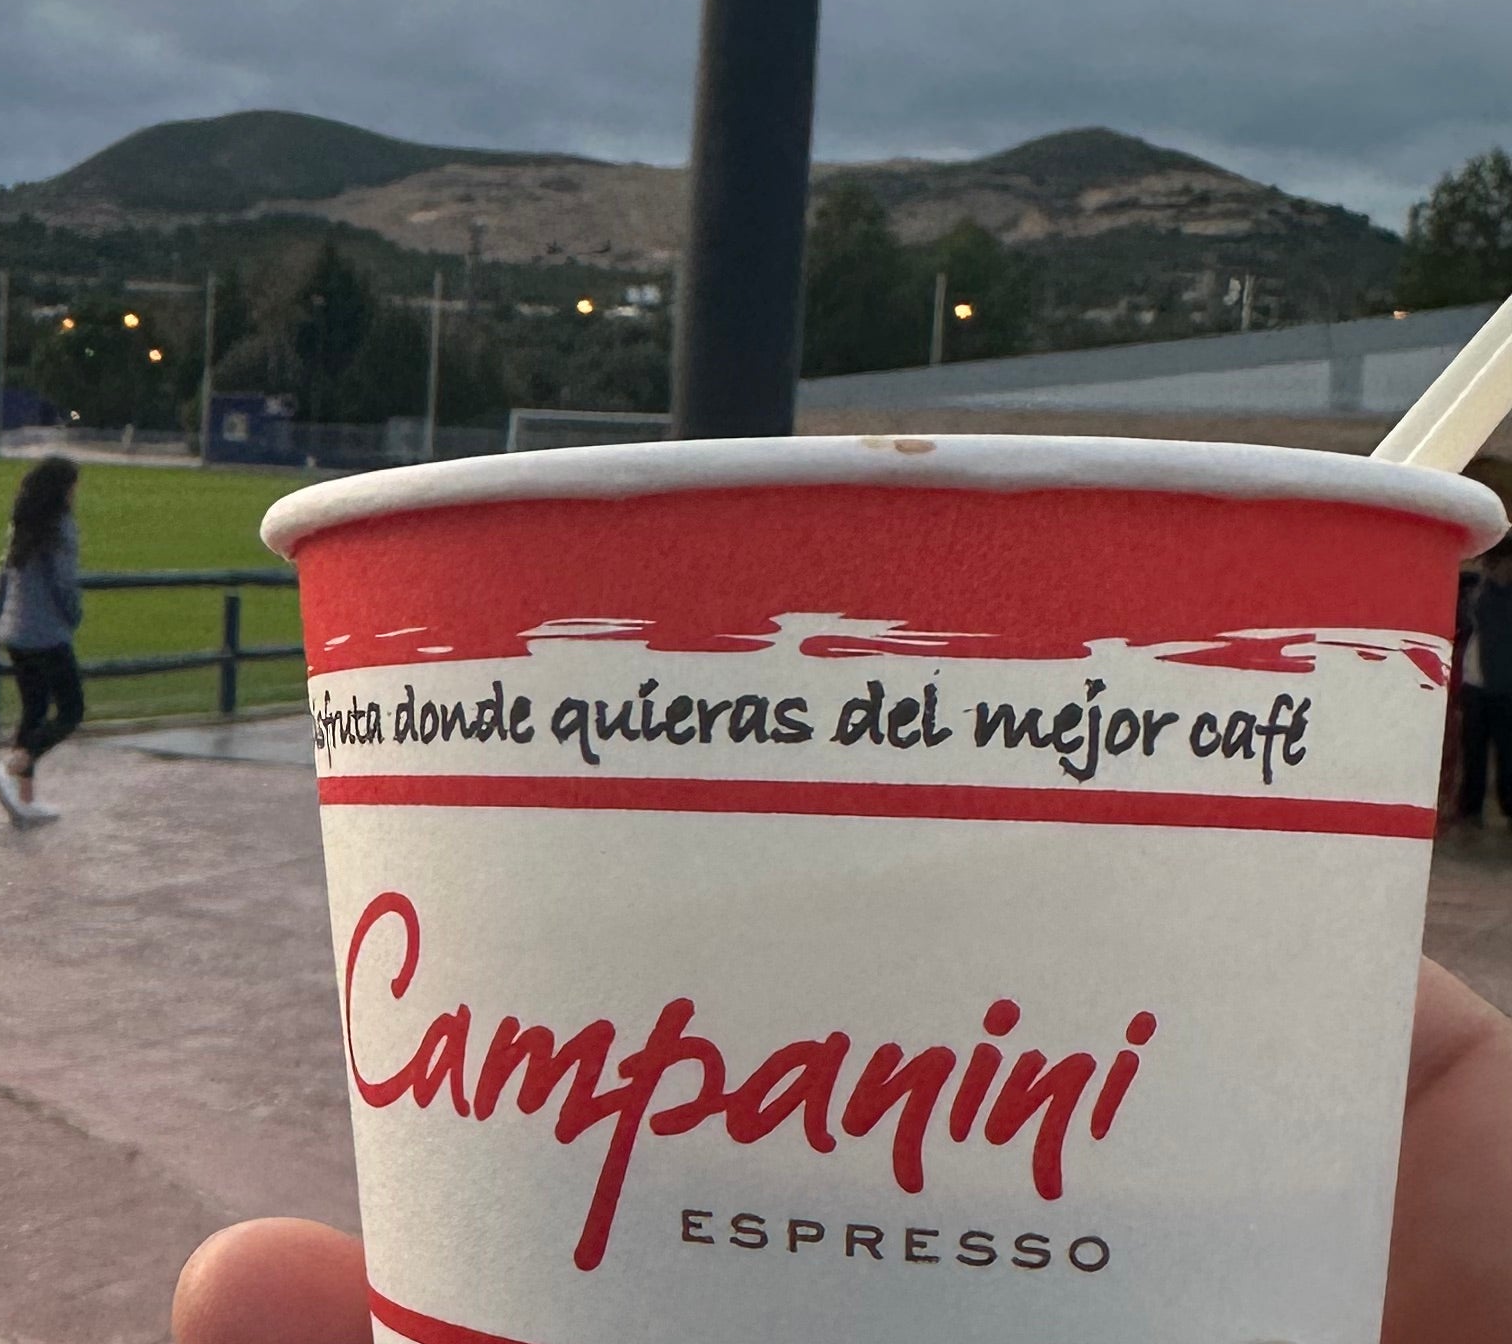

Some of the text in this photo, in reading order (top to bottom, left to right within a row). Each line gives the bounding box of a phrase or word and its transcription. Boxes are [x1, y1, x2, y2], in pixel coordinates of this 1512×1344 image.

[313, 672, 1308, 786] sfruta donde quieras del mejor café
[344, 891, 1158, 1272] Campanini
[680, 1208, 1112, 1274] ESPRESSO
